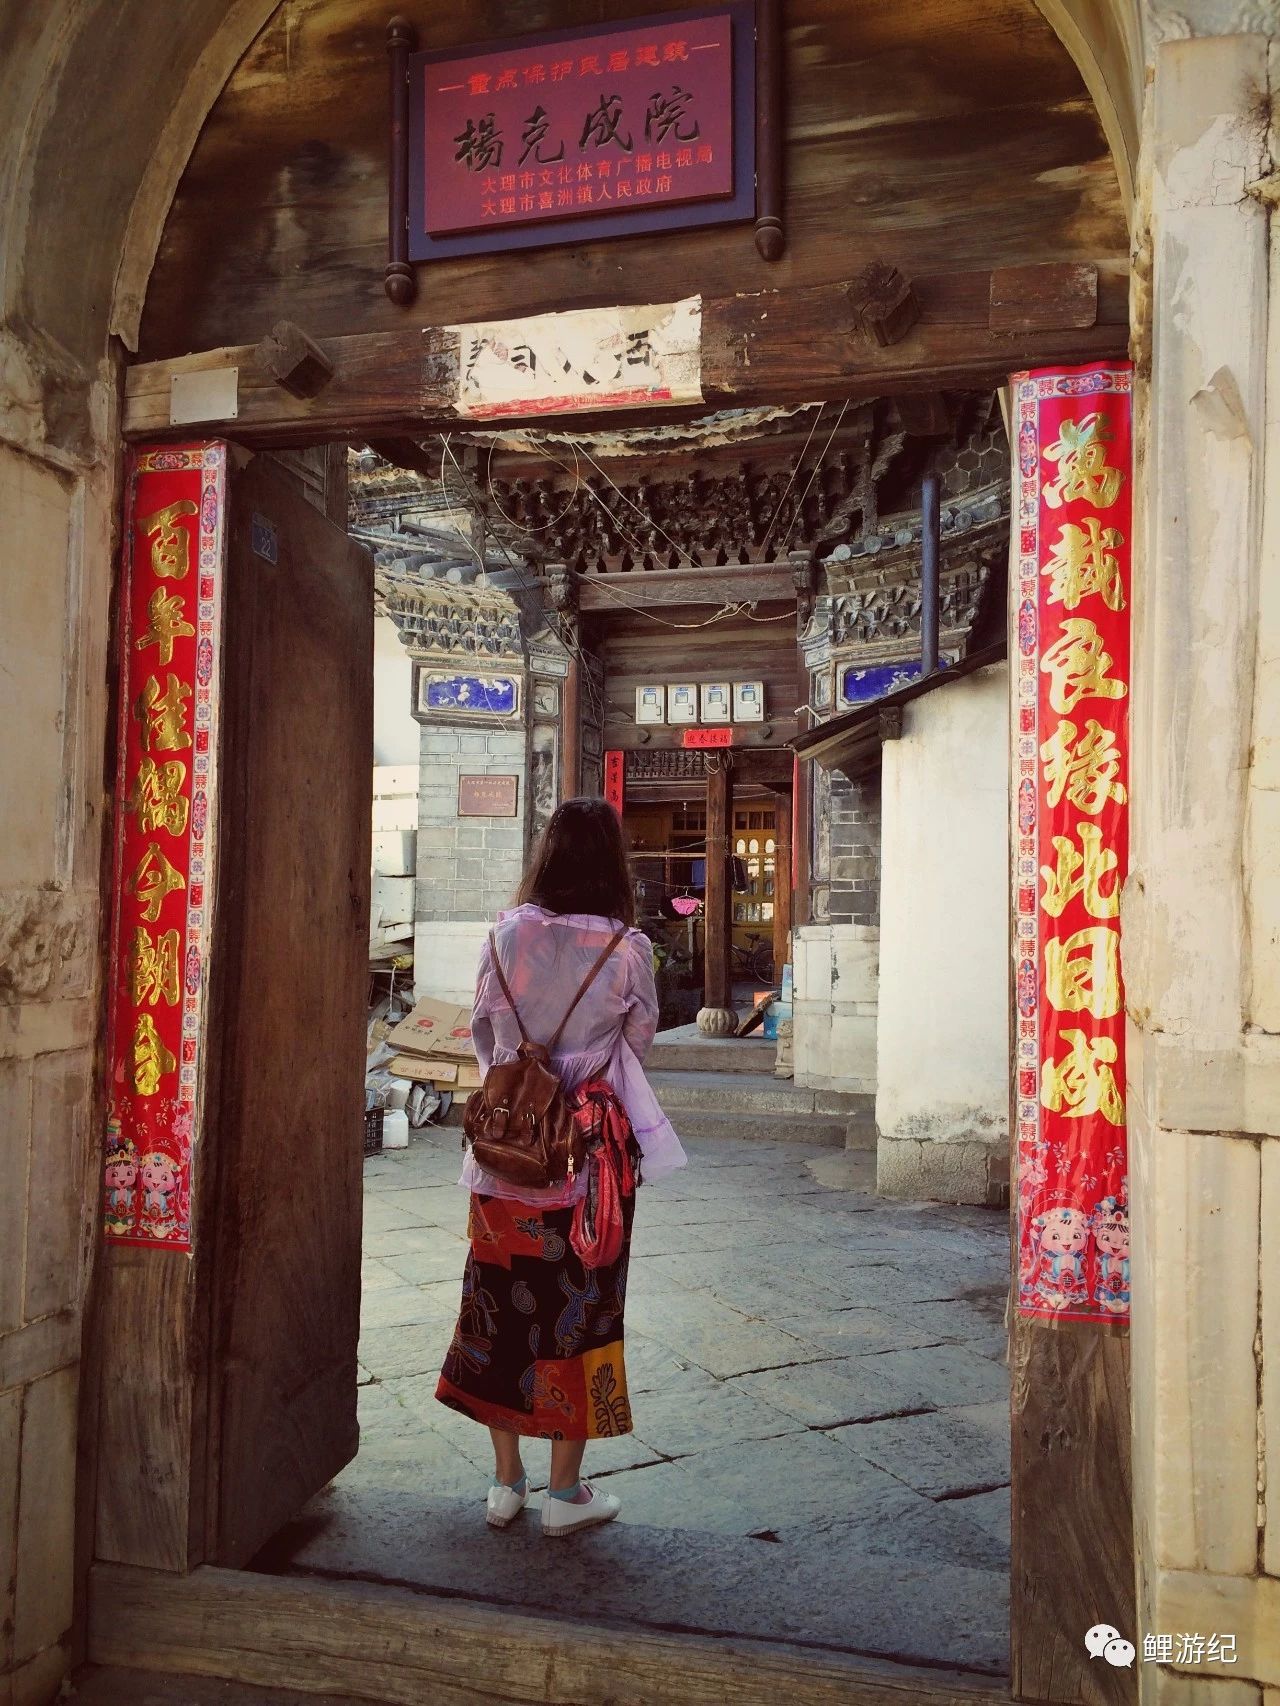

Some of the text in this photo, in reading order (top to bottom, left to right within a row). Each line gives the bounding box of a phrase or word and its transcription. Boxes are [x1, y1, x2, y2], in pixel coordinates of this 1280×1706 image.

[480, 145, 714, 197] 大理市文化体育广播电视局
[480, 174, 673, 218] 大理市喜洲镇人民政府
